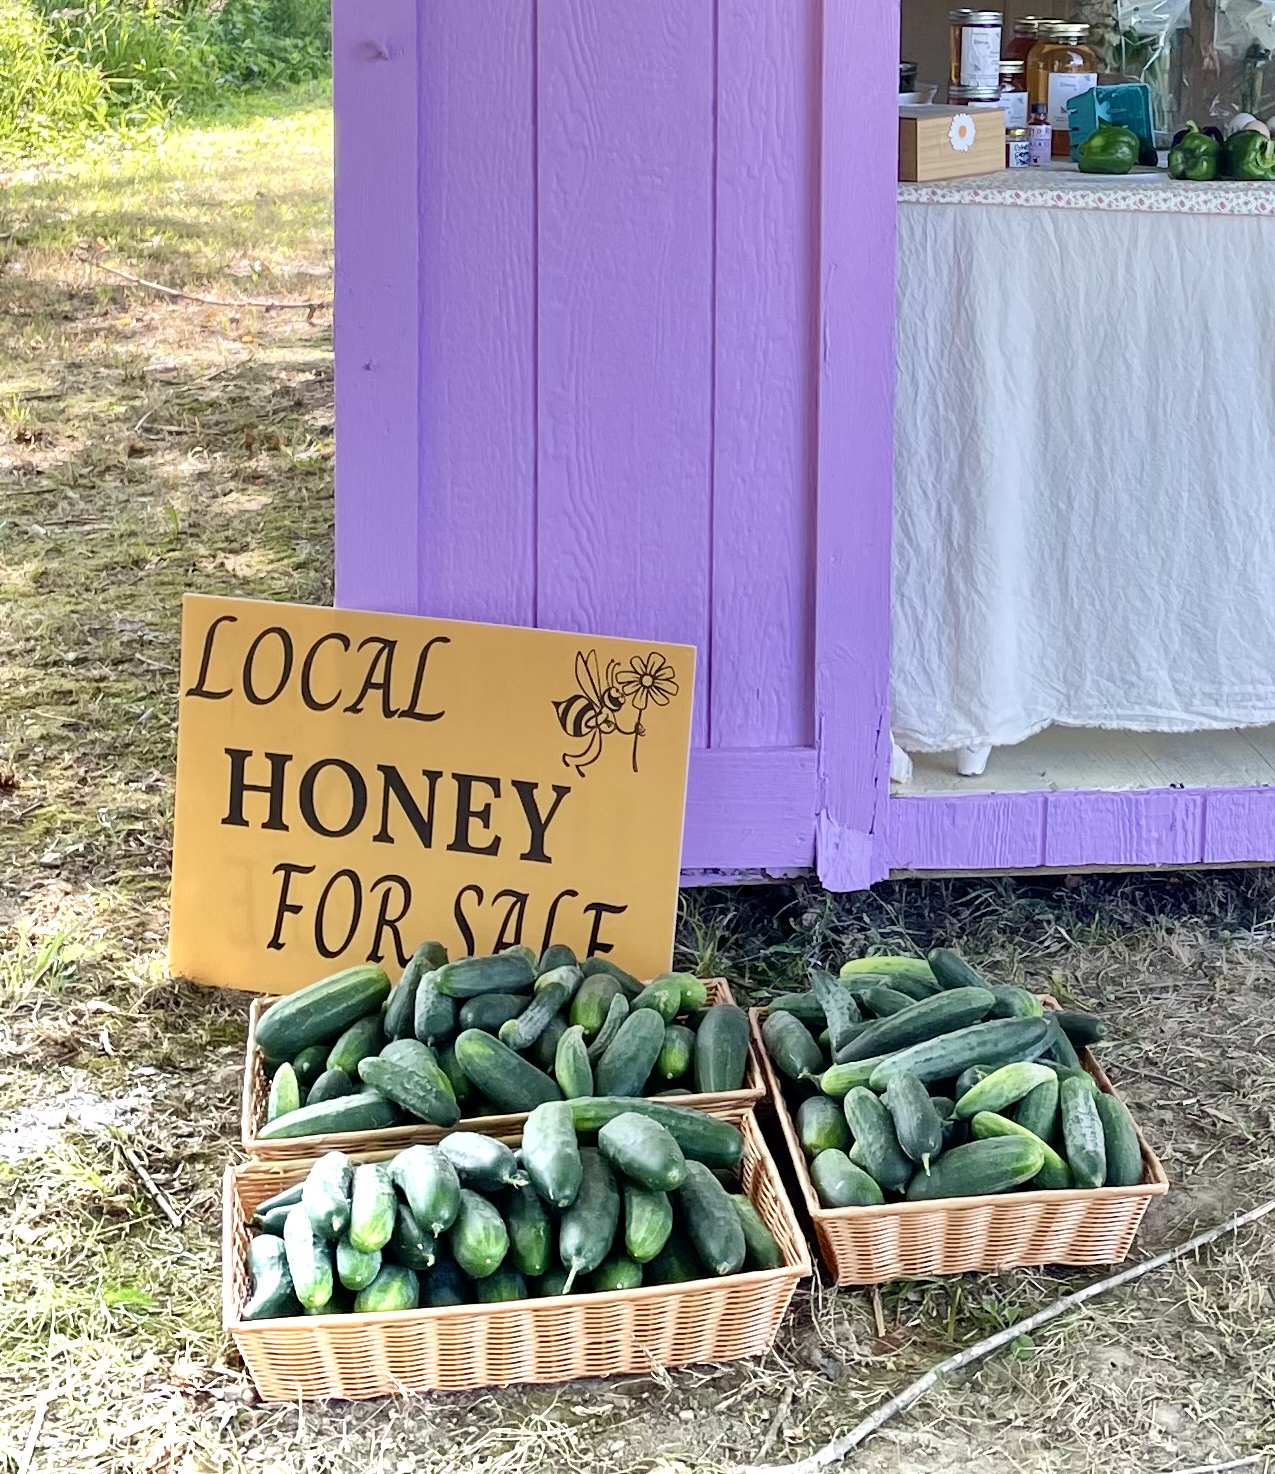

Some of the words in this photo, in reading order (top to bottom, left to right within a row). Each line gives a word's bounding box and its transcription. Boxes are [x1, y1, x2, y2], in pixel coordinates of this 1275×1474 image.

[185, 614, 451, 722] LOCAL
[220, 747, 572, 864] HONEY
[266, 862, 413, 969] FOR
